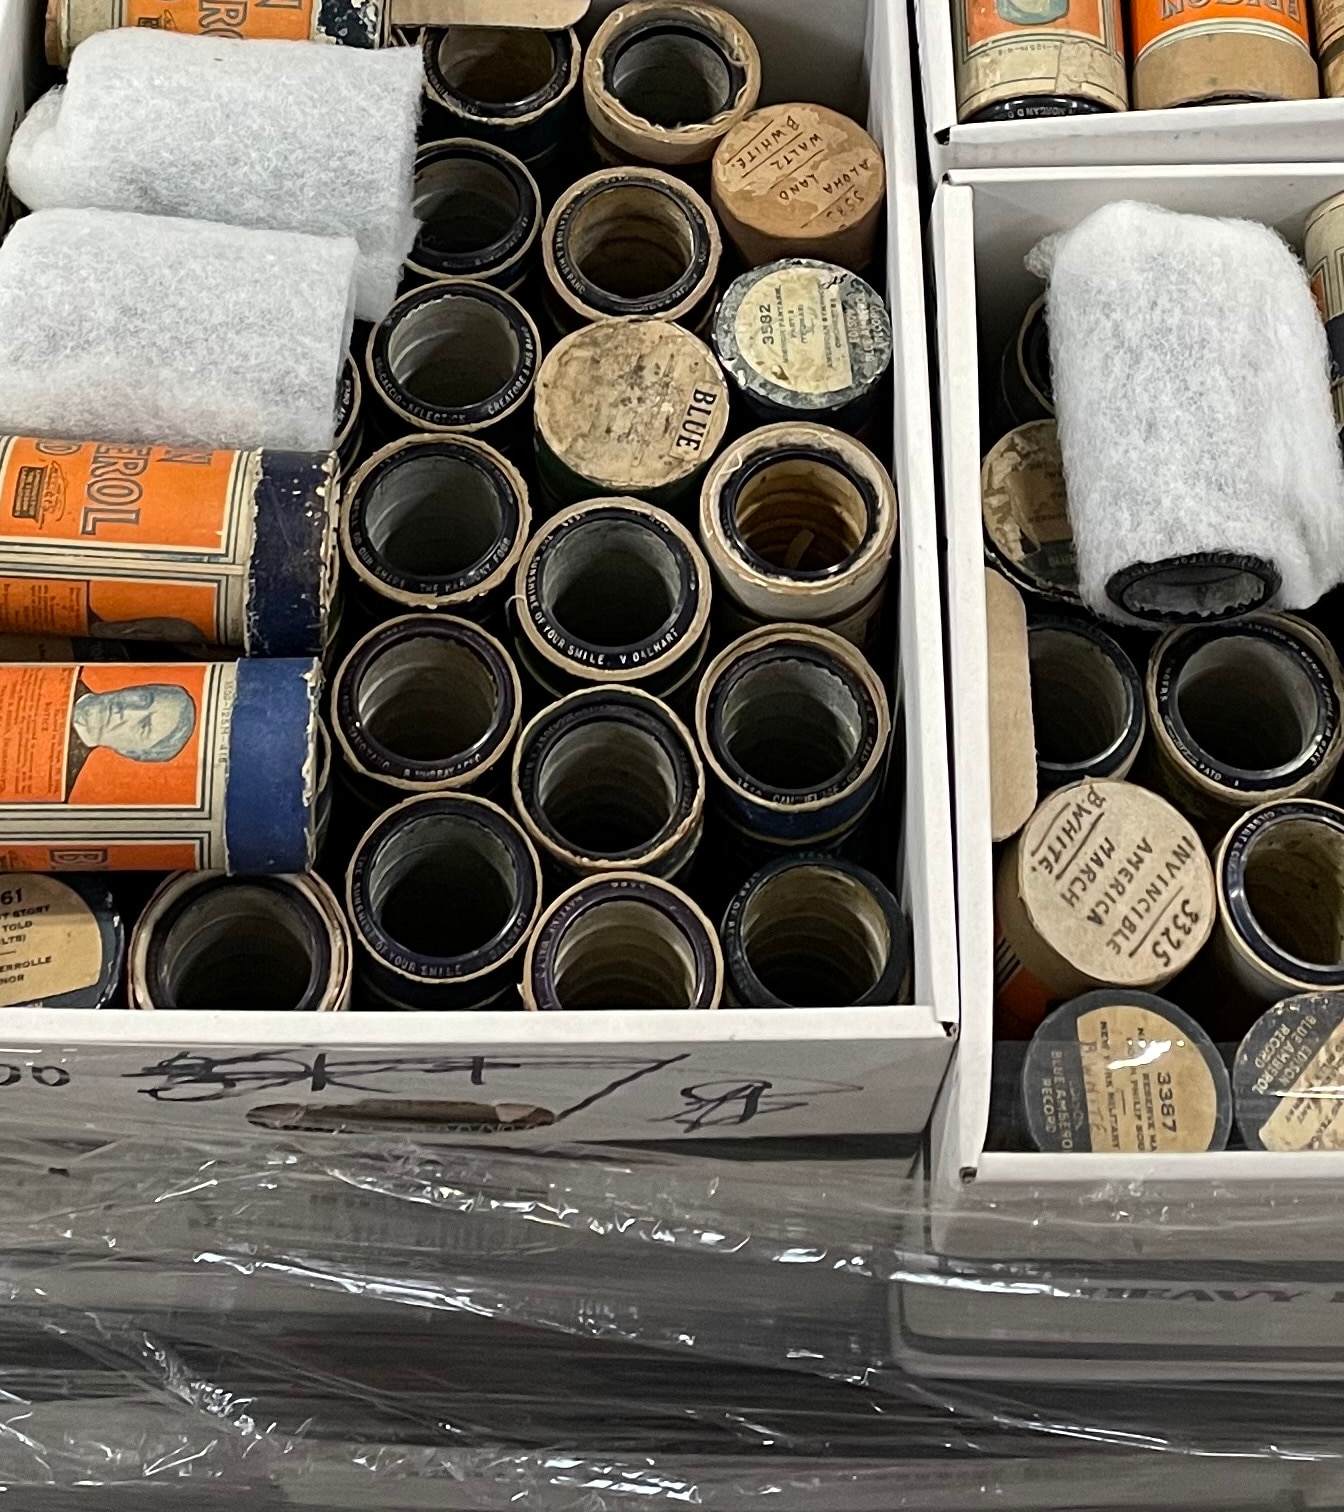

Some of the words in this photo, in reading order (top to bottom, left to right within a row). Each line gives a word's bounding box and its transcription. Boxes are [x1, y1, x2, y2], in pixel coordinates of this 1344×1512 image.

[779, 174, 819, 200] LAND
[823, 158, 870, 194] ALOHA
[760, 303, 774, 345] 3582
[675, 387, 718, 452] BLUE
[535, 611, 546, 624] OF
[543, 625, 567, 649] YOUR
[567, 645, 605, 665] SMILE
[1060, 836, 1115, 908] MARCH
[1086, 836, 1153, 925] AMERICA
[1107, 836, 1196, 955] INVINCIBLE
[2, 921, 33, 934] TOLD
[12, 904, 50, 917] STORY
[1152, 899, 1199, 967] 3325
[389, 953, 416, 972] YOUR
[420, 965, 463, 976] SMILE
[1255, 1023, 1291, 1068] RECORD
[1291, 1015, 1317, 1043] BLUE
[1252, 1041, 1295, 1095] AMBEROL
[1157, 1072, 1177, 1133] 3387
